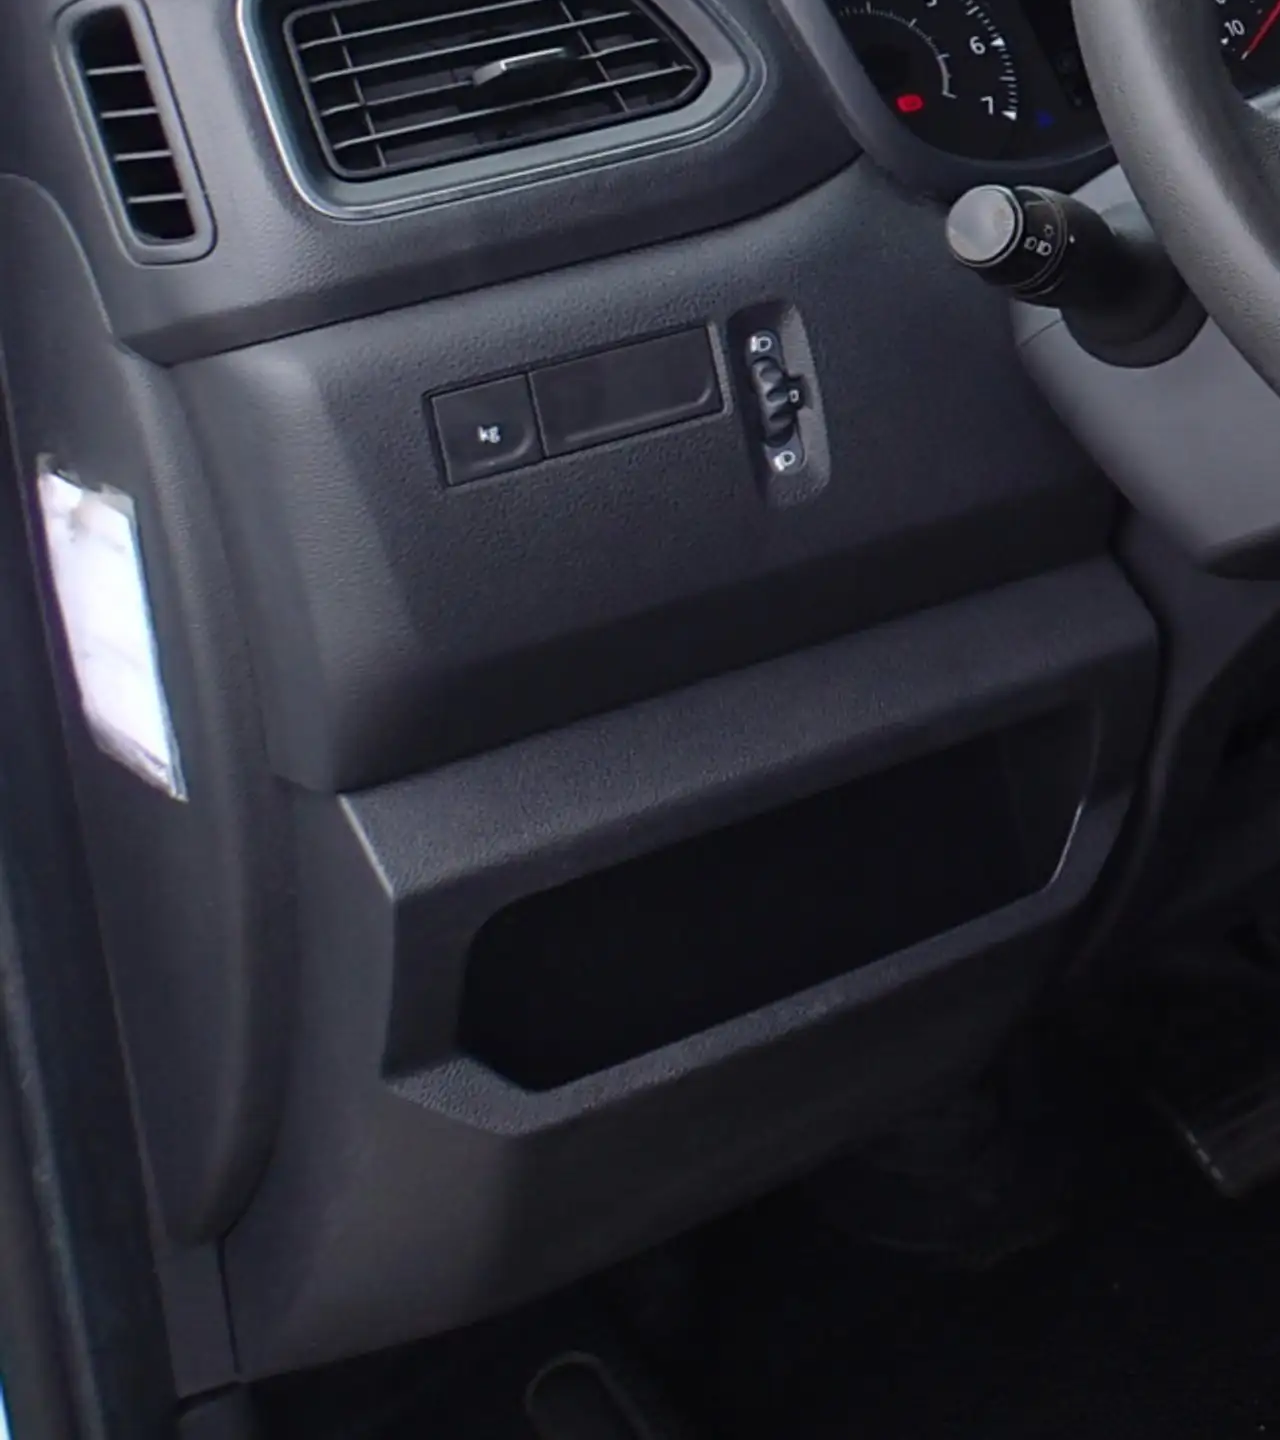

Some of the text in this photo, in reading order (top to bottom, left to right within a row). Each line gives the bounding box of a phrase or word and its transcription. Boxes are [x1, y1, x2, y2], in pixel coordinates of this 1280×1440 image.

[1224, 20, 1246, 37] 10
[969, 35, 987, 56] 6
[980, 95, 995, 115] 7
